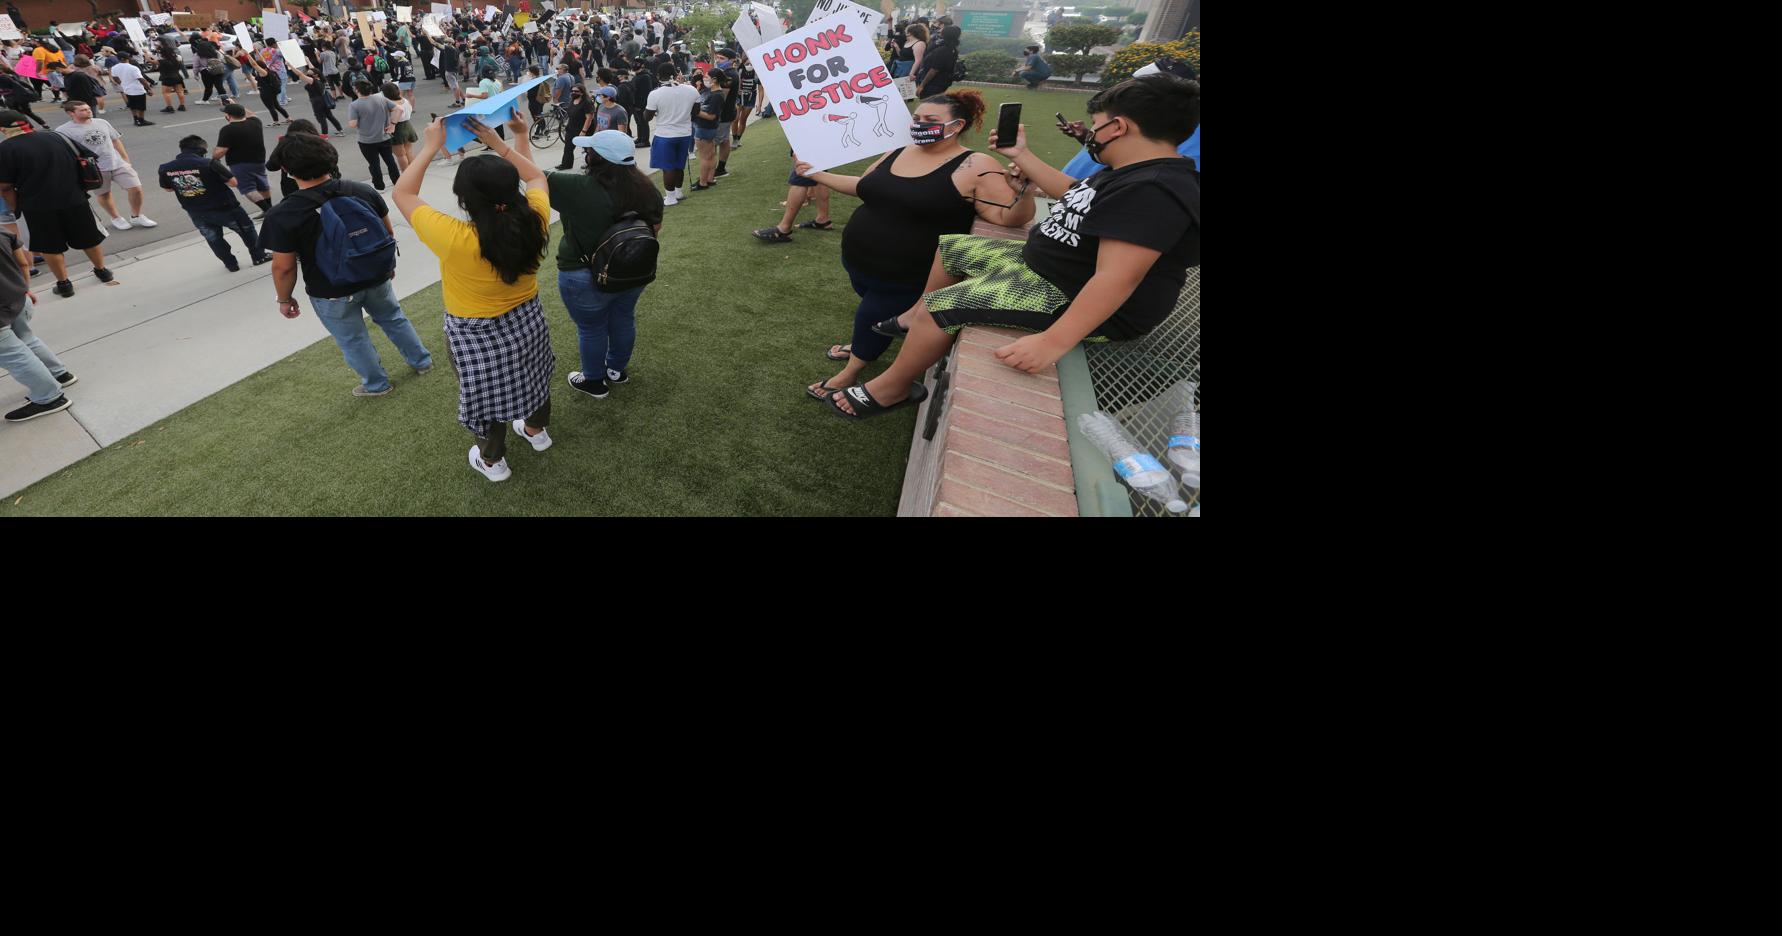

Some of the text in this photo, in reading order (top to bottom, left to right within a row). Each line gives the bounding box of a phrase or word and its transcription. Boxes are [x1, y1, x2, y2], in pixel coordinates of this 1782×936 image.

[763, 24, 853, 71] HONK
[779, 65, 893, 121] JUSTICE
[788, 56, 849, 89] FOR
